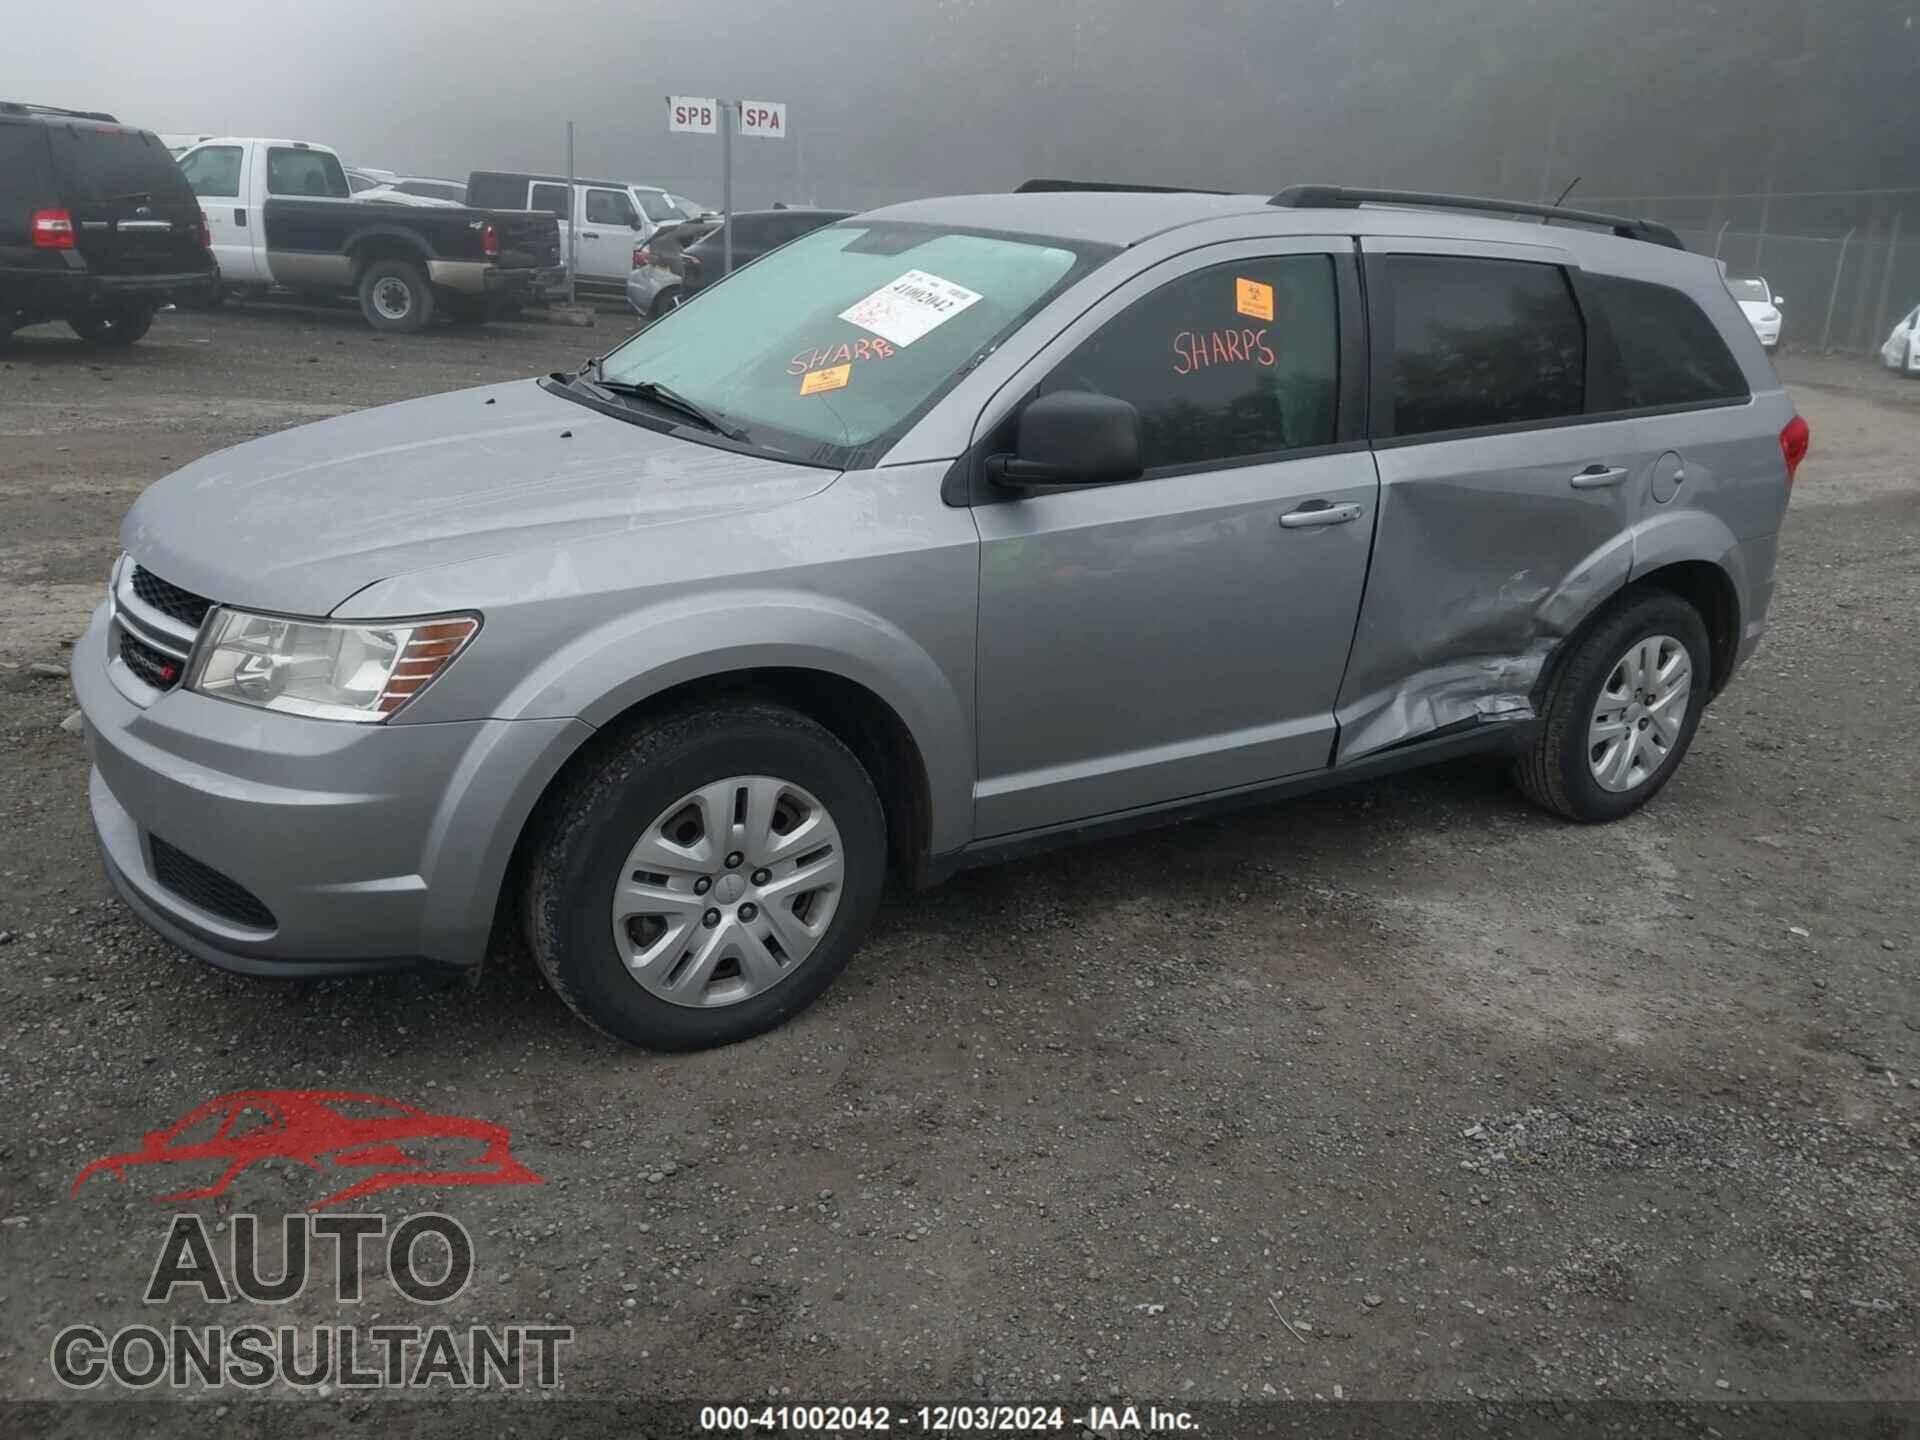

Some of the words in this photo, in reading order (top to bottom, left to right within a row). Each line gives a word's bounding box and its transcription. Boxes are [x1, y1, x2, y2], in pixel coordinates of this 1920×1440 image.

[675, 106, 712, 126] SPB
[746, 108, 780, 129] SPA
[1173, 329, 1275, 374] SHARPS
